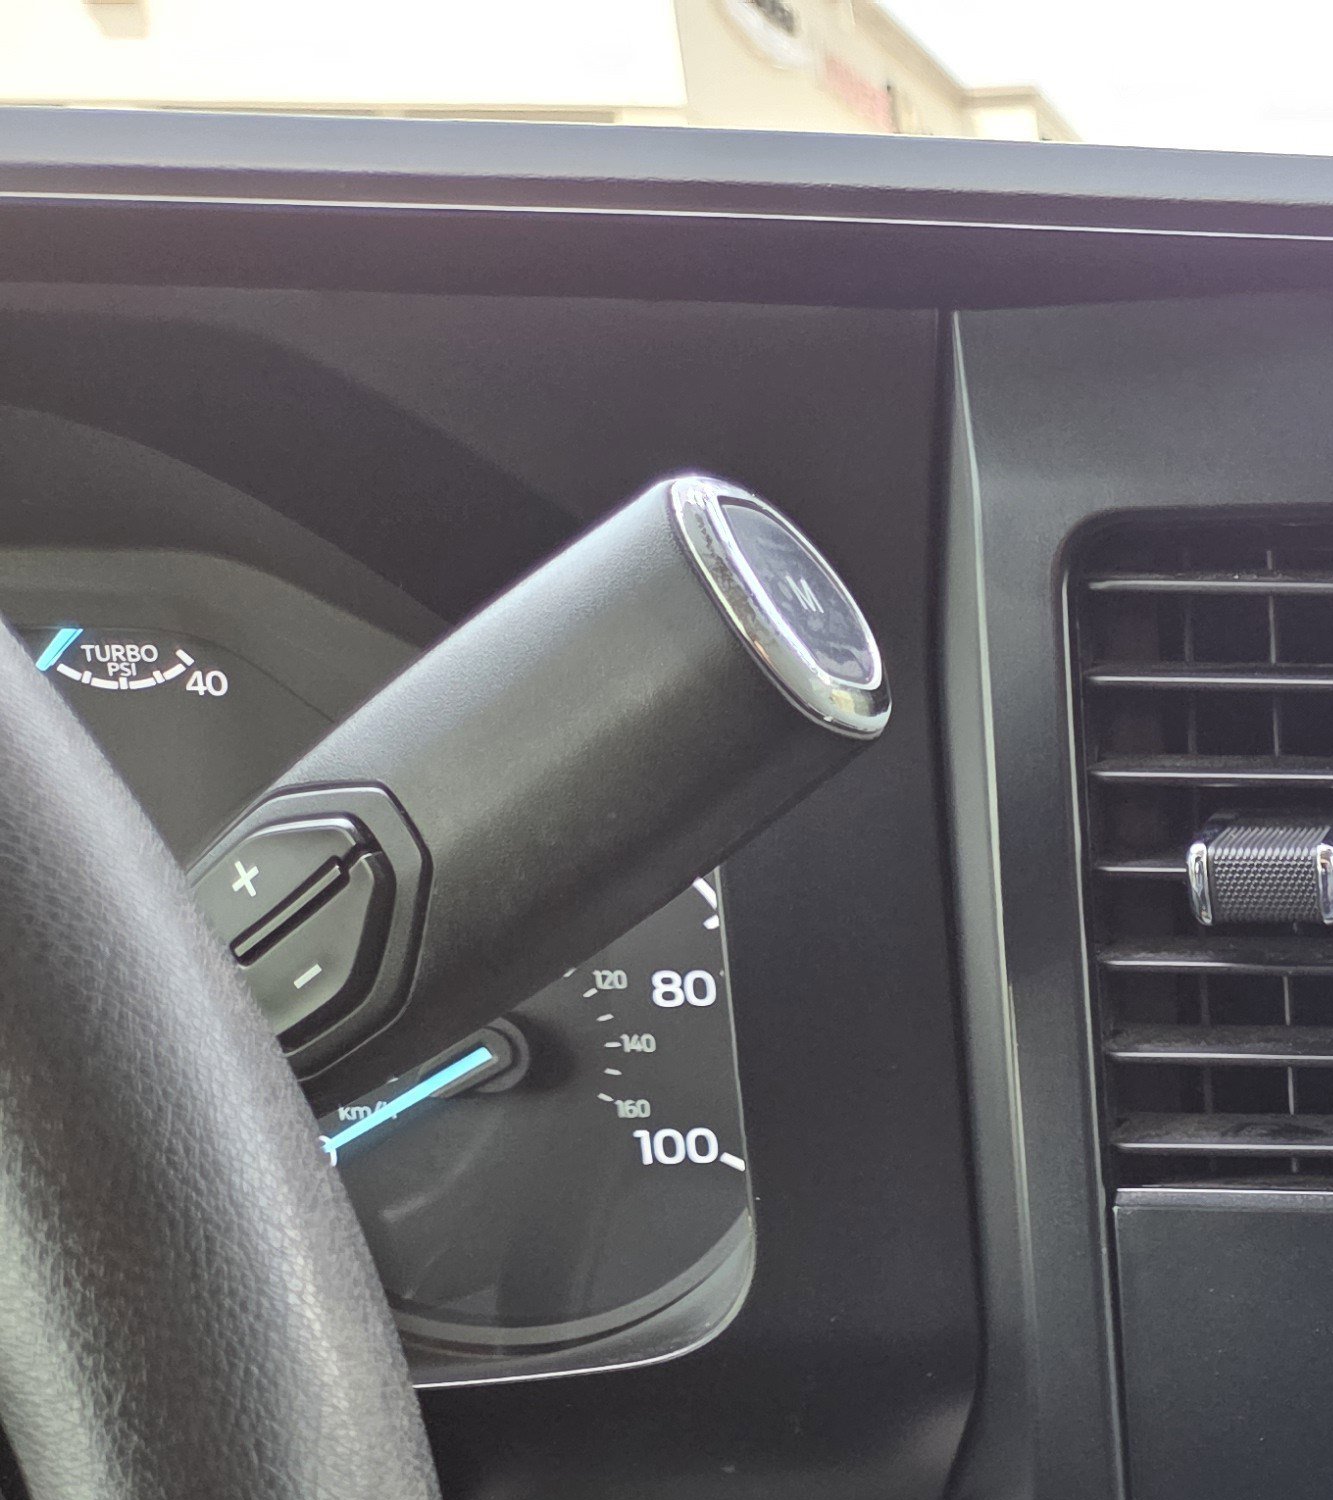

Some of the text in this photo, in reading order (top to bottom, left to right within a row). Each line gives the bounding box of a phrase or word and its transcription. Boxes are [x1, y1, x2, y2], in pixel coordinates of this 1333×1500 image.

[81, 644, 159, 662] TURBO
[107, 662, 137, 677] PSI
[186, 670, 229, 696] 40
[594, 970, 628, 990] 120
[651, 969, 718, 1008] 80
[620, 1034, 657, 1053] 140
[338, 1101, 398, 1120] km/
[614, 1099, 651, 1119] 160
[632, 1127, 719, 1166] 100
